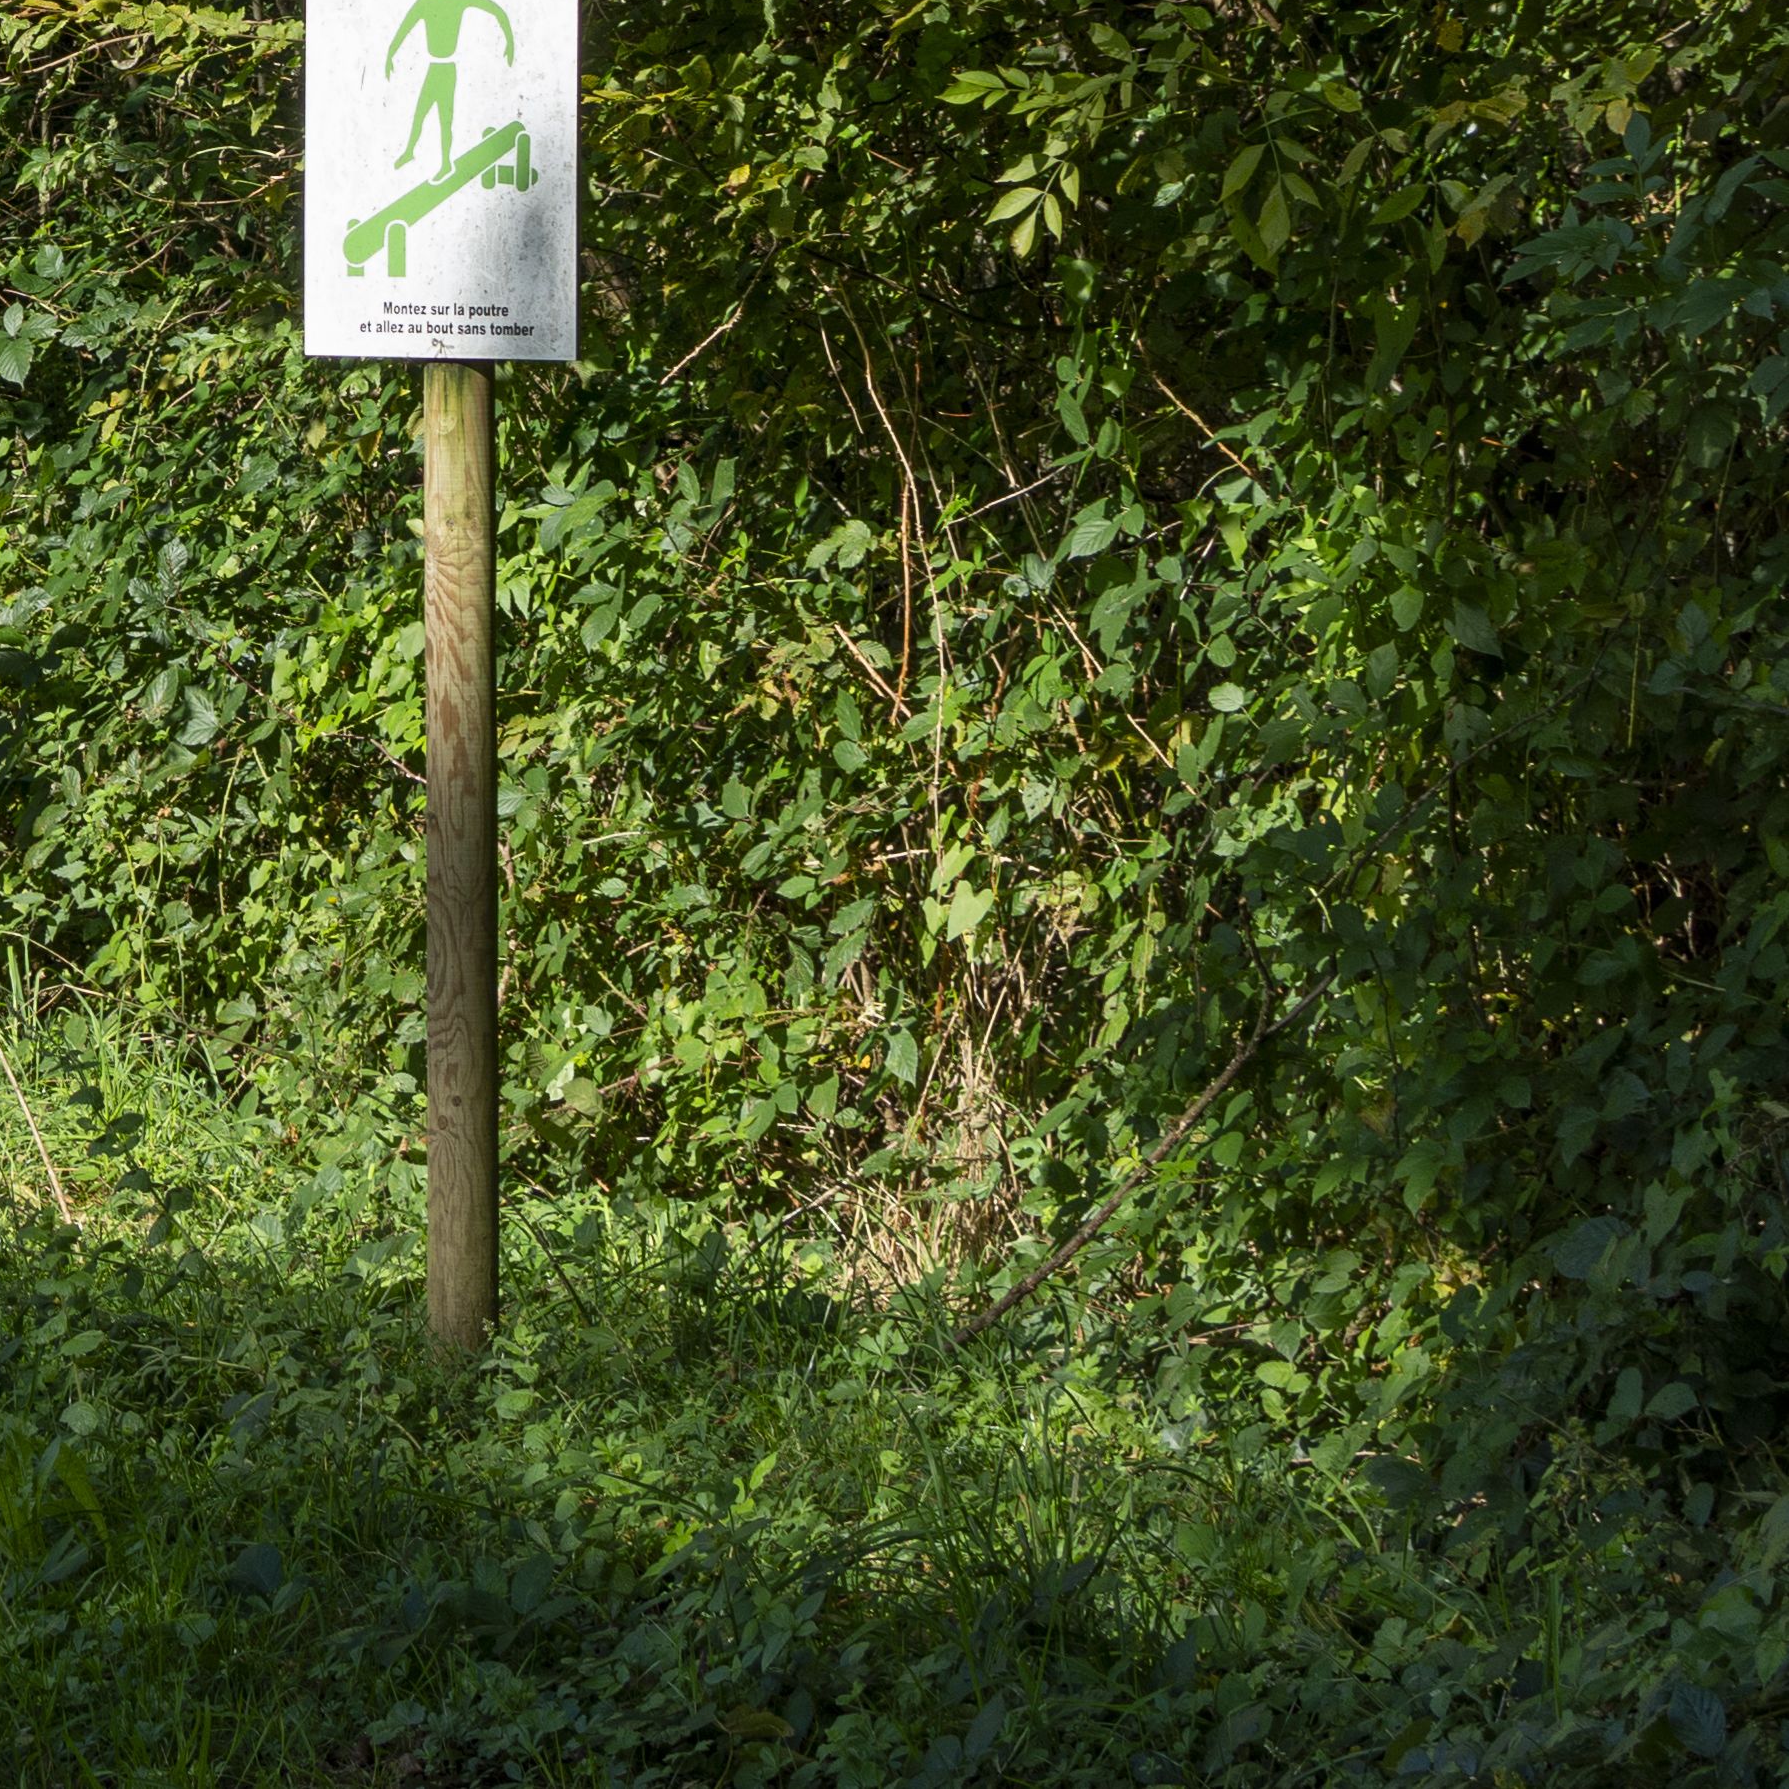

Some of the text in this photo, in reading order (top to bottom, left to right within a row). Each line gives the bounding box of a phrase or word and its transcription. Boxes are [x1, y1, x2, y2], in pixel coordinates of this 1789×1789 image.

[383, 301, 509, 320] Montez sur la poutre
[359, 320, 535, 337] et allez au bout sans tomber
